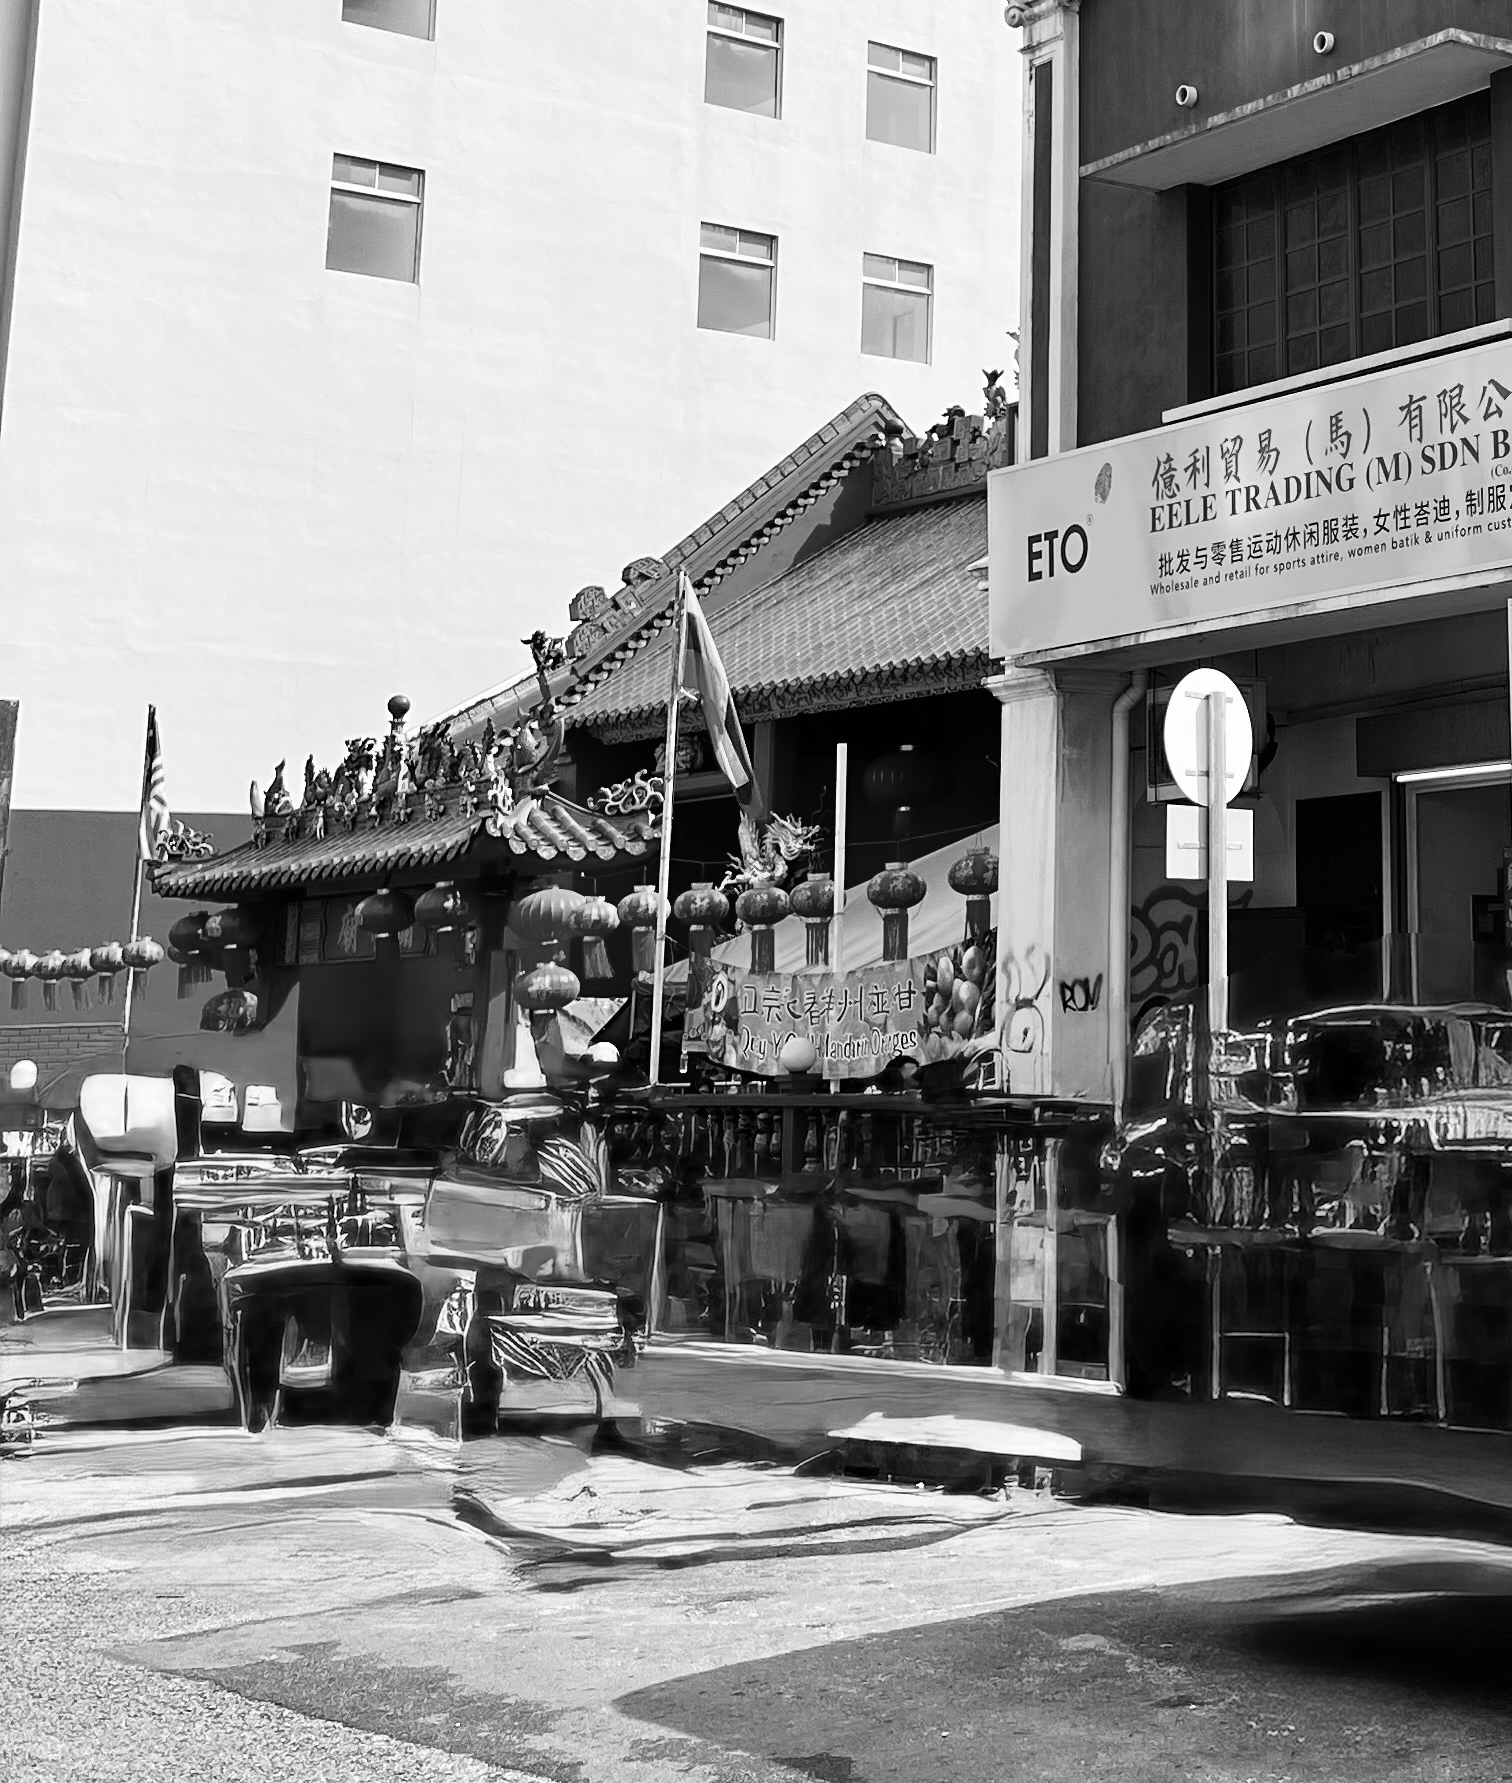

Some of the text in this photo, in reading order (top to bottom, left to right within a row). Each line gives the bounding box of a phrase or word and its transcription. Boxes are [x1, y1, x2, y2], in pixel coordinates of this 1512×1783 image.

[1149, 493, 1217, 533] EELE
[1225, 462, 1356, 517] TRADING
[1366, 451, 1412, 491] (M)
[1421, 434, 1480, 476] SDN
[1028, 524, 1088, 582] ETO
[1149, 578, 1199, 596] Wholesale
[1202, 572, 1221, 586] and
[1224, 566, 1251, 582] retail
[1254, 562, 1270, 576] for
[1273, 556, 1306, 574] sports
[1310, 550, 1344, 566] attire,
[1347, 542, 1387, 558] women
[1391, 533, 1420, 550] batik
[1424, 531, 1433, 544] &
[1437, 523, 1482, 542] uniform
